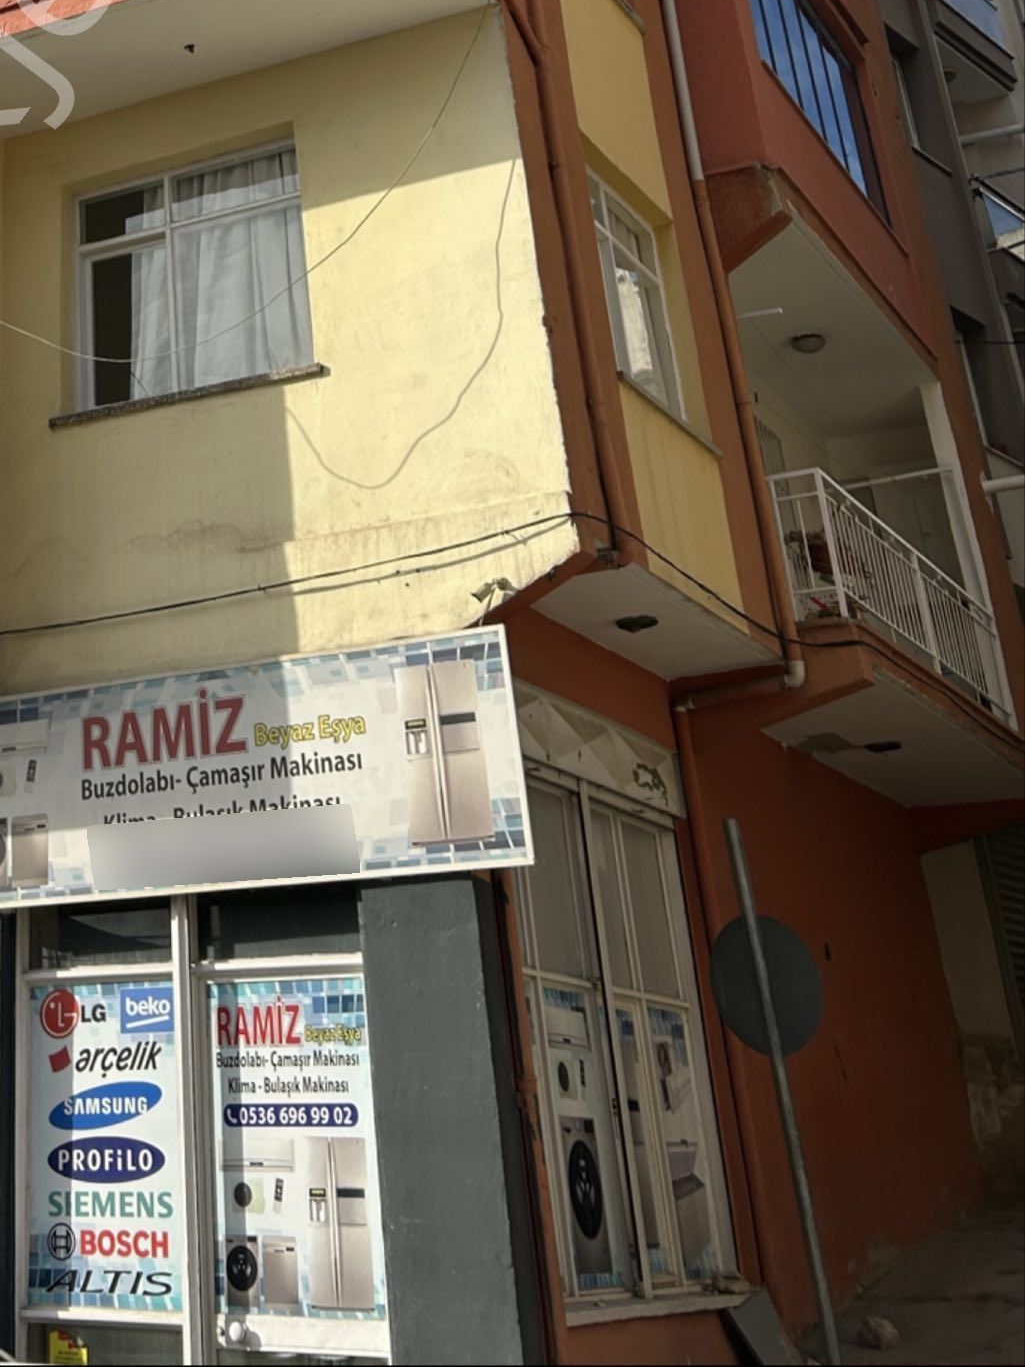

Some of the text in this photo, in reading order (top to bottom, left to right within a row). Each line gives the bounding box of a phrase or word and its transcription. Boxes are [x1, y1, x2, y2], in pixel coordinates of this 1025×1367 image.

[82, 687, 248, 772] RAMİZ
[253, 714, 367, 750] Beyaz Eşya
[186, 762, 265, 794] Çamaşır
[270, 750, 363, 780] Makinası
[81, 1004, 106, 1023] LG
[126, 996, 171, 1016] beko
[216, 995, 302, 1046] RAMİZ
[74, 1041, 162, 1078] arçelik
[270, 1050, 311, 1072] Çamaşır
[313, 1049, 360, 1067] Makinası
[228, 1076, 257, 1094] Klima
[263, 1076, 301, 1099] Bulaşık
[302, 1076, 349, 1094] Makinası
[63, 1096, 148, 1116] SAMSUNG
[239, 1106, 353, 1125] 0536 696 99 02
[47, 1190, 174, 1219] SIEMENS
[80, 1229, 169, 1259] BOSCH
[45, 1269, 173, 1297] ALTIS
